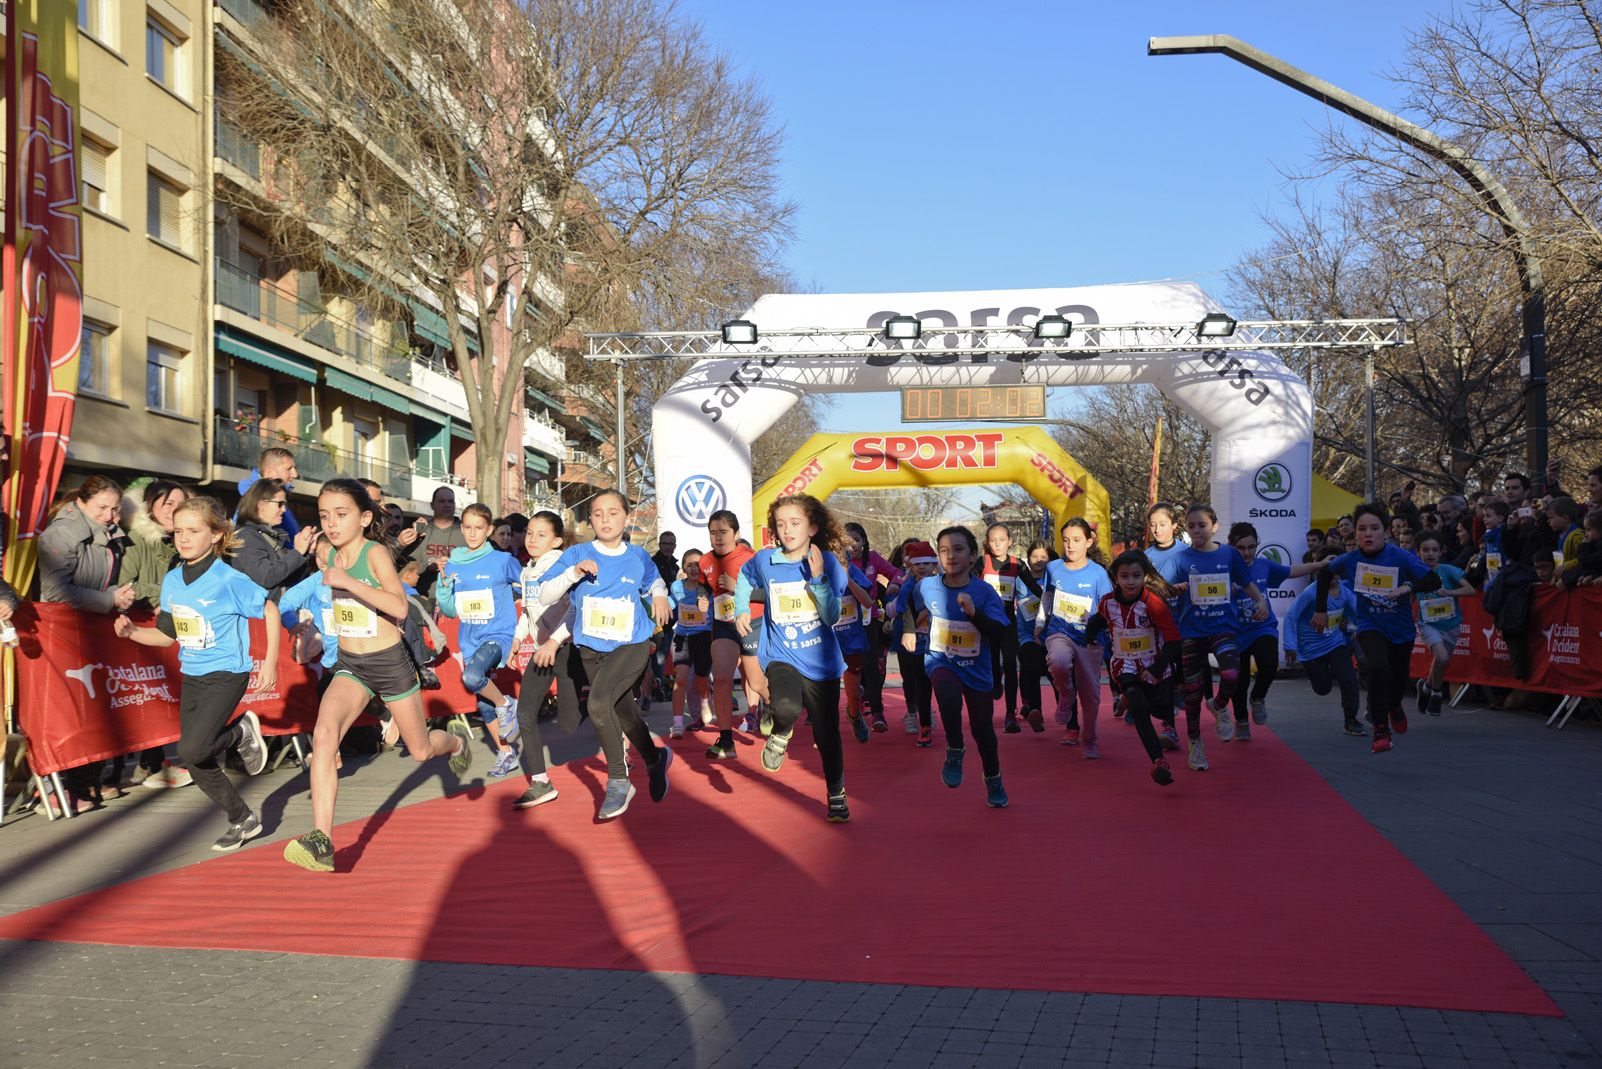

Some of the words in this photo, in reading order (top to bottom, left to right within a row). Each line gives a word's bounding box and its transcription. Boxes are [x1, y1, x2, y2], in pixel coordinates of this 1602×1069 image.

[866, 304, 1100, 367] sarsa
[1201, 350, 1270, 407] arsa
[849, 432, 1004, 473] SPORT
[1029, 452, 1085, 500] SPORT
[1249, 507, 1297, 518] ŠKODA
[1372, 577, 1381, 585] 21
[1268, 590, 1297, 599] ODA
[470, 602, 481, 611] 183
[791, 598, 802, 609] 76
[341, 610, 354, 622] 59
[800, 636, 822, 648] sarsa
[952, 635, 962, 645] 91
[1128, 640, 1141, 649] 197
